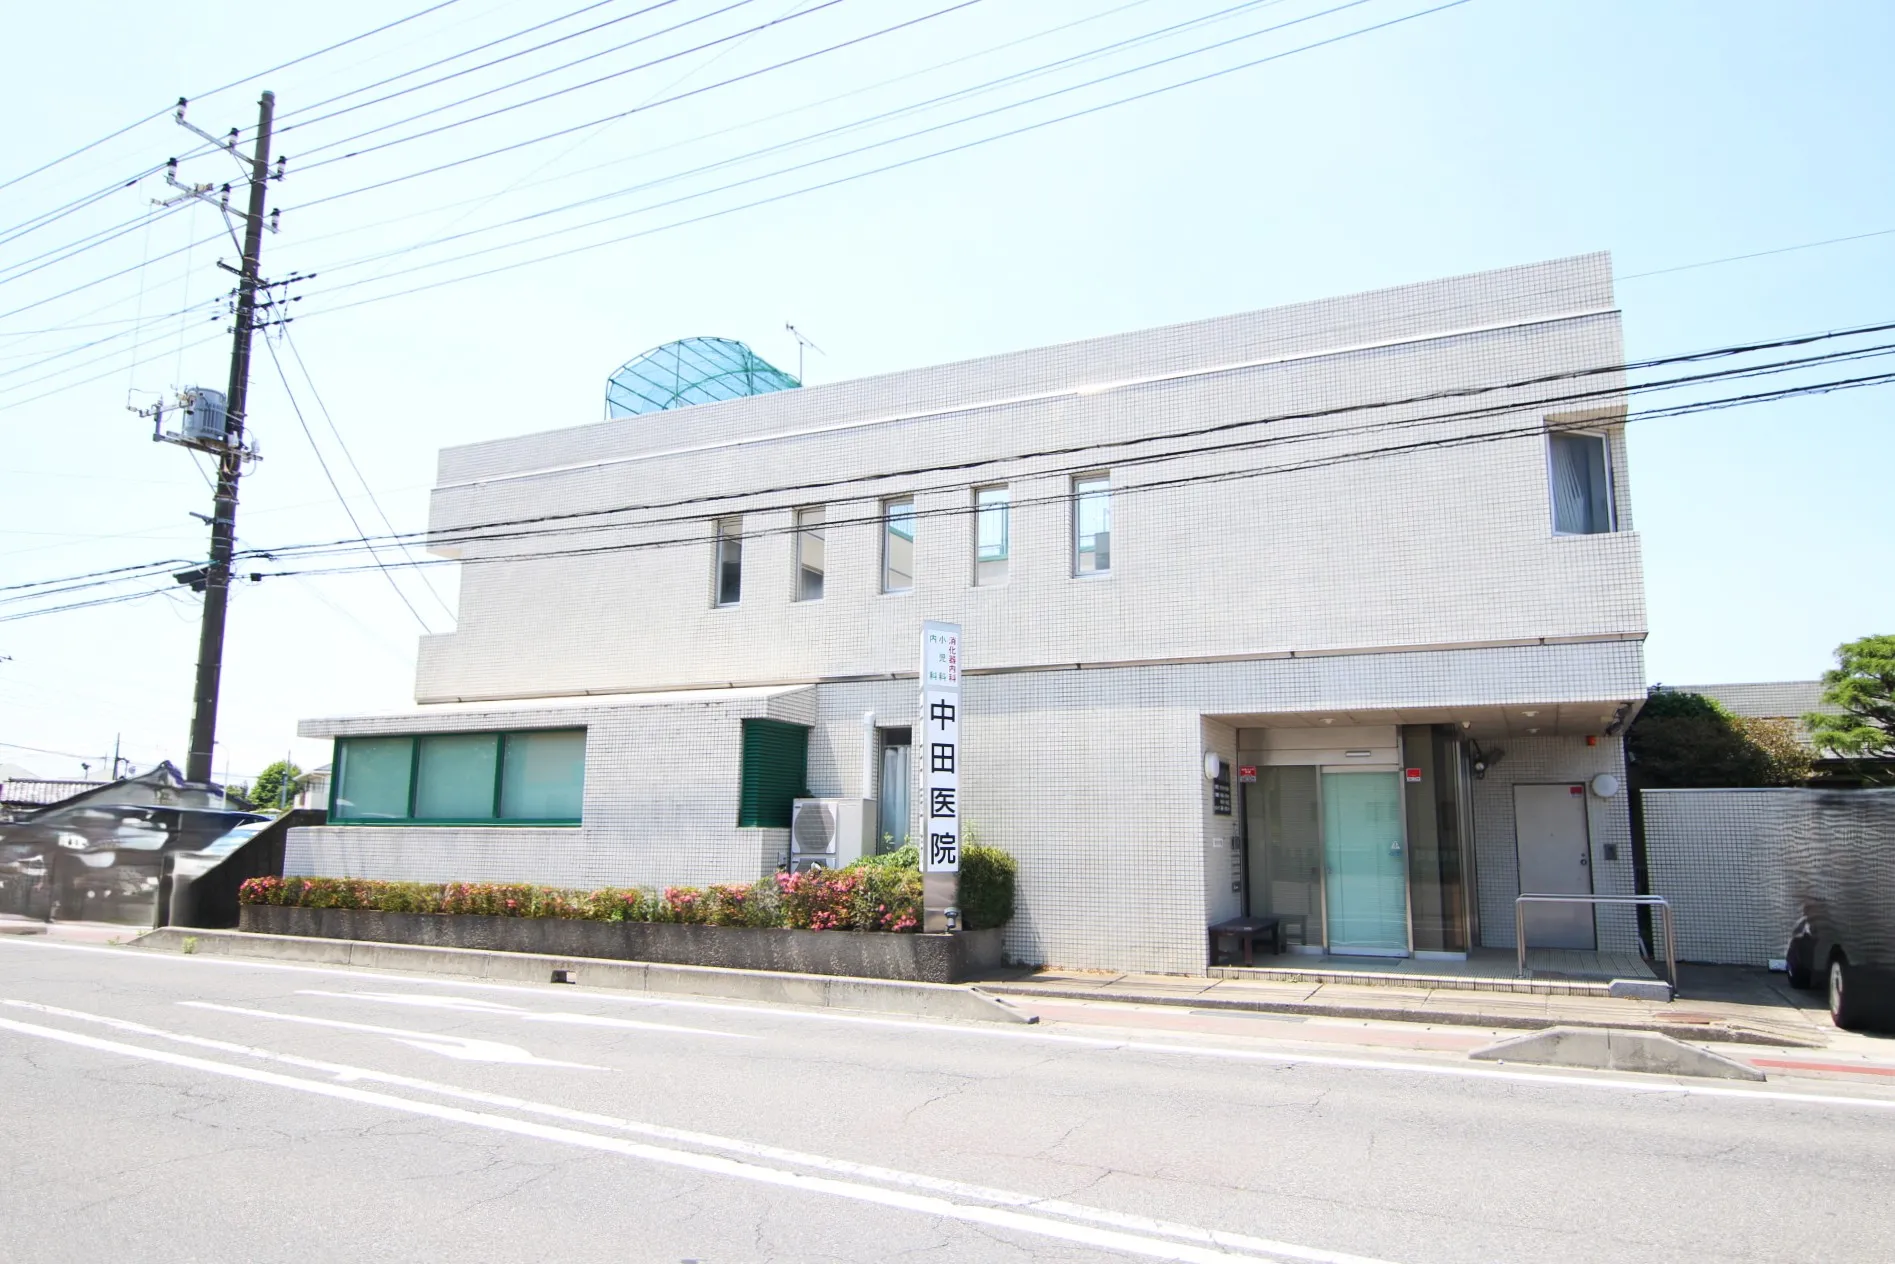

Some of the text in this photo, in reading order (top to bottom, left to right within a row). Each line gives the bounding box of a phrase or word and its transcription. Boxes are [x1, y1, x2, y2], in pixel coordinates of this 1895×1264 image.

[929, 634, 938, 681] 内科
[938, 635, 947, 681] 小児科
[948, 636, 957, 683] 消化器内科
[930, 698, 956, 865] 中田医院
